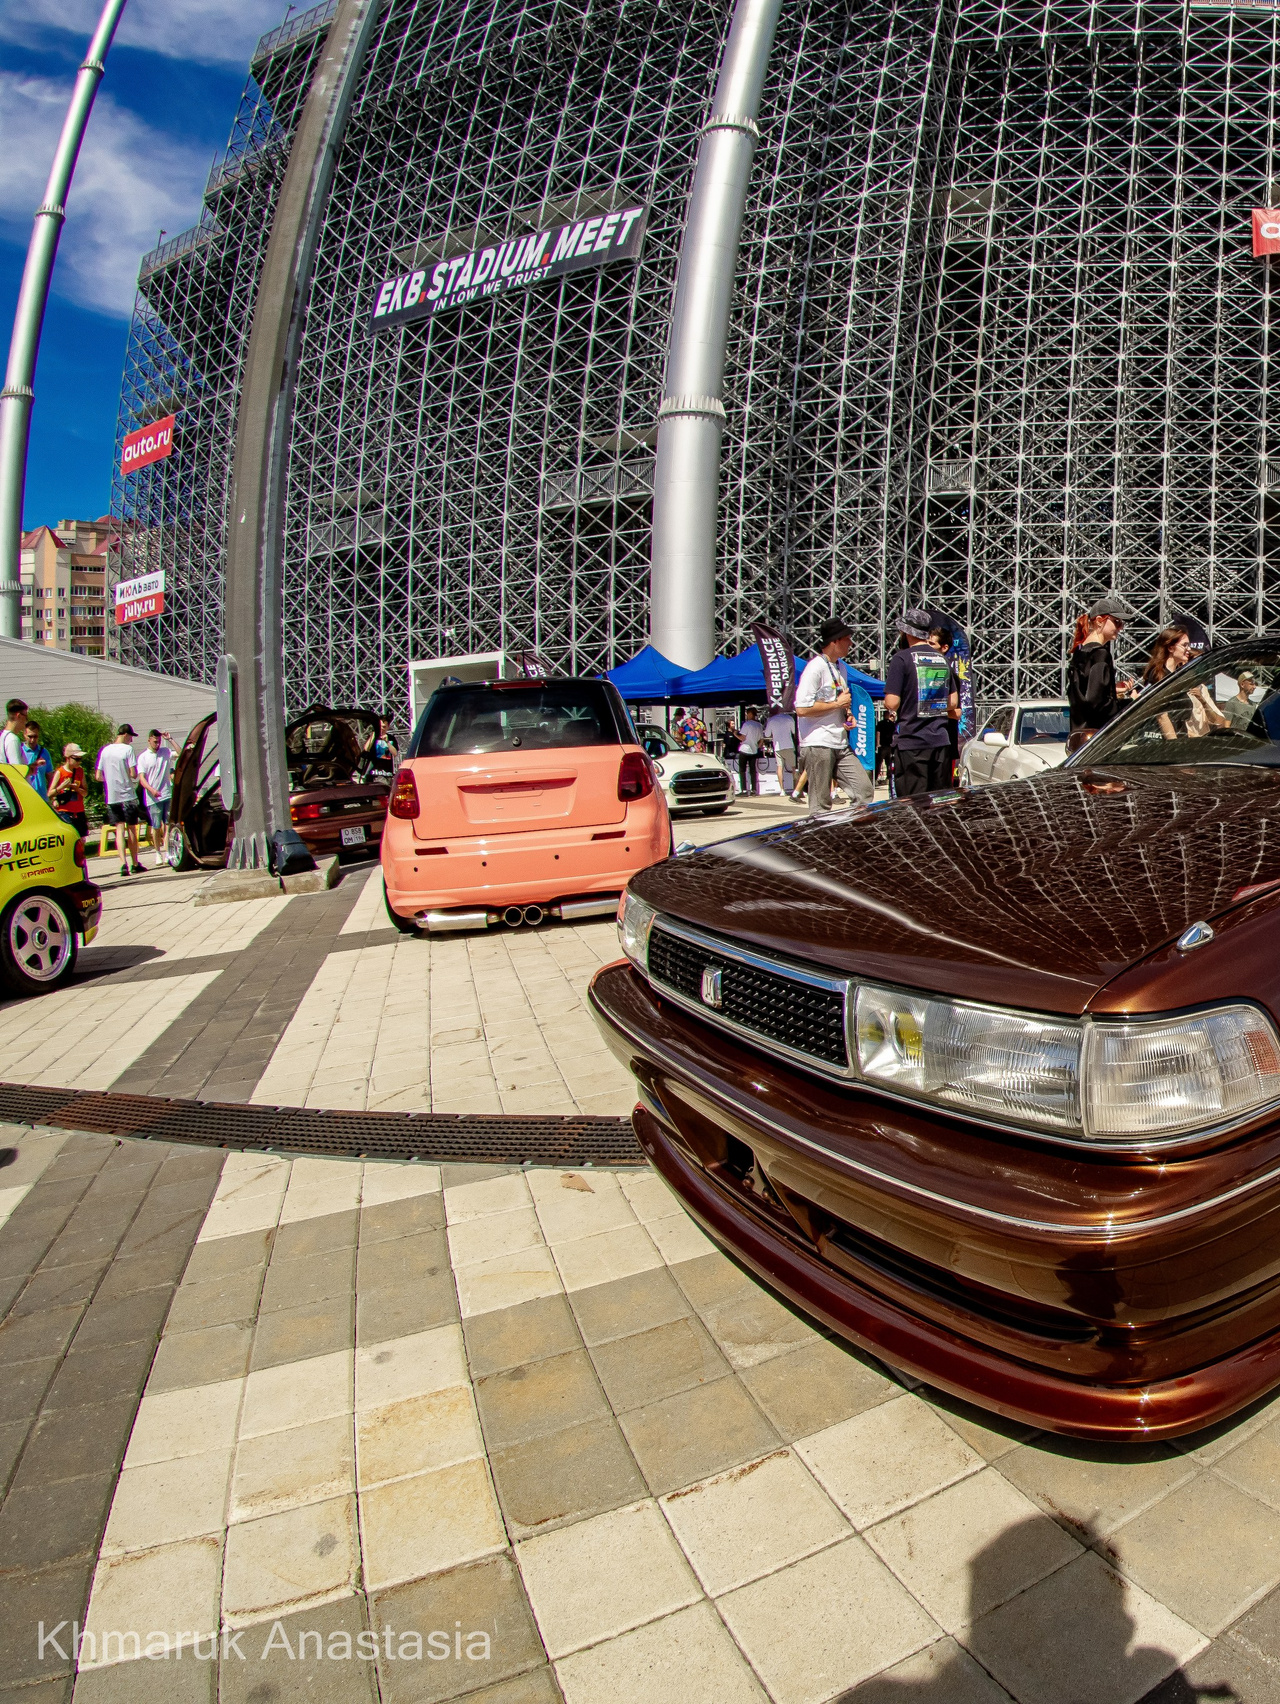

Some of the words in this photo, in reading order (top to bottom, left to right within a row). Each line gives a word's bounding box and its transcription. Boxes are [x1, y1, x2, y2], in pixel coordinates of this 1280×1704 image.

[433, 297, 447, 312] IN
[451, 287, 477, 307] LOW
[482, 280, 502, 296] WE
[507, 266, 552, 289] TRUST
[124, 427, 171, 462] auto.ru
[119, 584, 143, 599] ИЮЛЬ
[123, 597, 156, 622] july.ru
[761, 637, 784, 709] XPERIENCE
[773, 637, 789, 682] DARKSIDE
[15, 834, 65, 856] MUGEN
[0, 855, 42, 872] TEC
